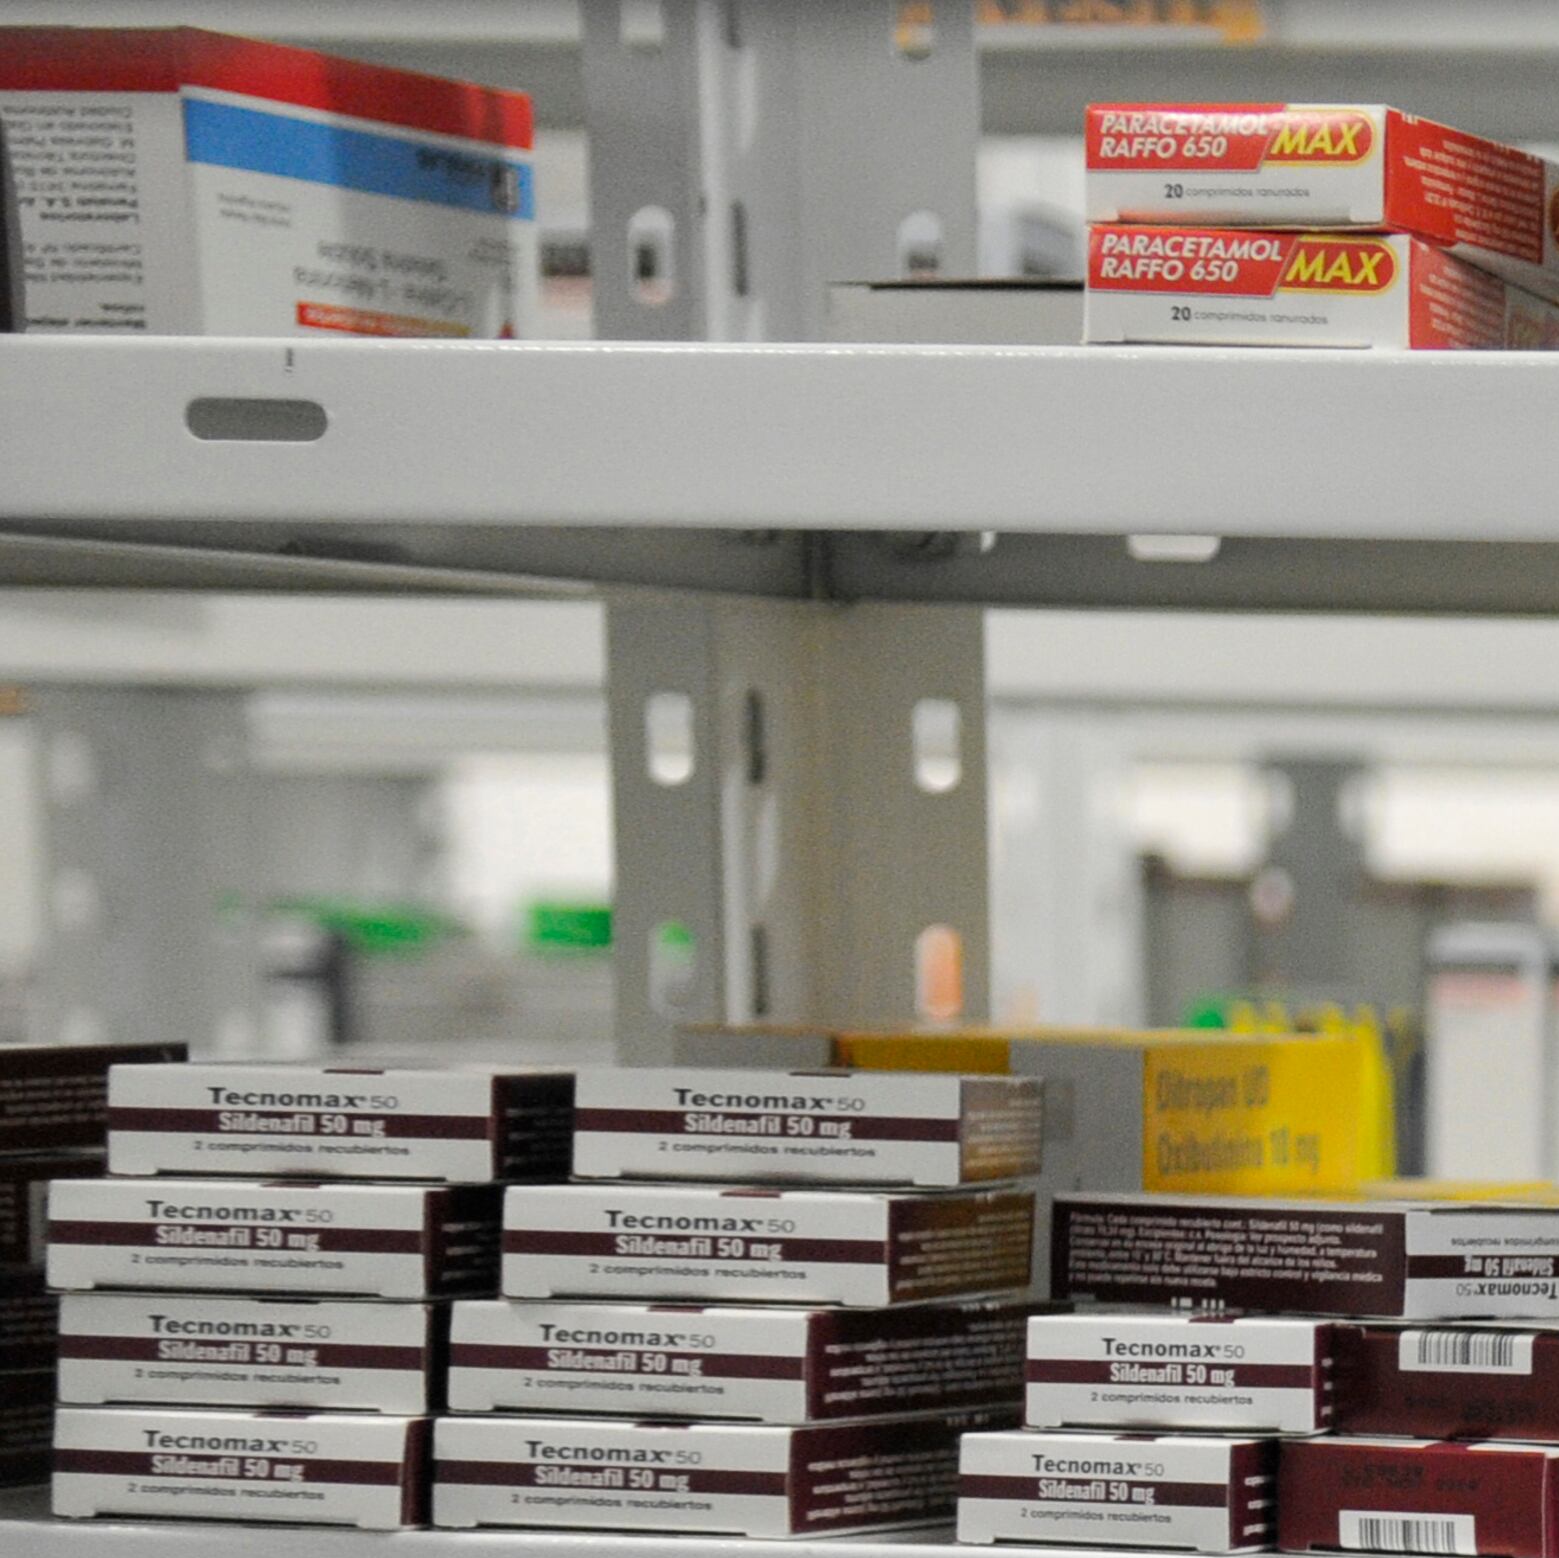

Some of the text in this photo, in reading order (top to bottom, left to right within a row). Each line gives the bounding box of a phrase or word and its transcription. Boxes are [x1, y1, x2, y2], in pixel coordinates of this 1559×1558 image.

[1100, 112, 1268, 136] PARACETAMOL
[1100, 137, 1227, 158] RAFFO 650
[1270, 124, 1364, 156] MAX
[1103, 234, 1283, 262] PARACETAMOL
[1102, 261, 1238, 282] RAFFO 650
[1285, 251, 1383, 285] MAX
[1172, 306, 1191, 322] 20
[371, 1096, 398, 1110] 50
[836, 1098, 864, 1112] 50
[219, 1112, 385, 1138] Sildenafil 50 mg
[1223, 1345, 1244, 1359] 50
[1110, 1363, 1235, 1388] Sildenafil 50 mg
[1101, 1393, 1180, 1406] comprimidos
[1184, 1393, 1253, 1406] recubiertos
[675, 1450, 702, 1465] 50
[1144, 1463, 1164, 1477] 50
